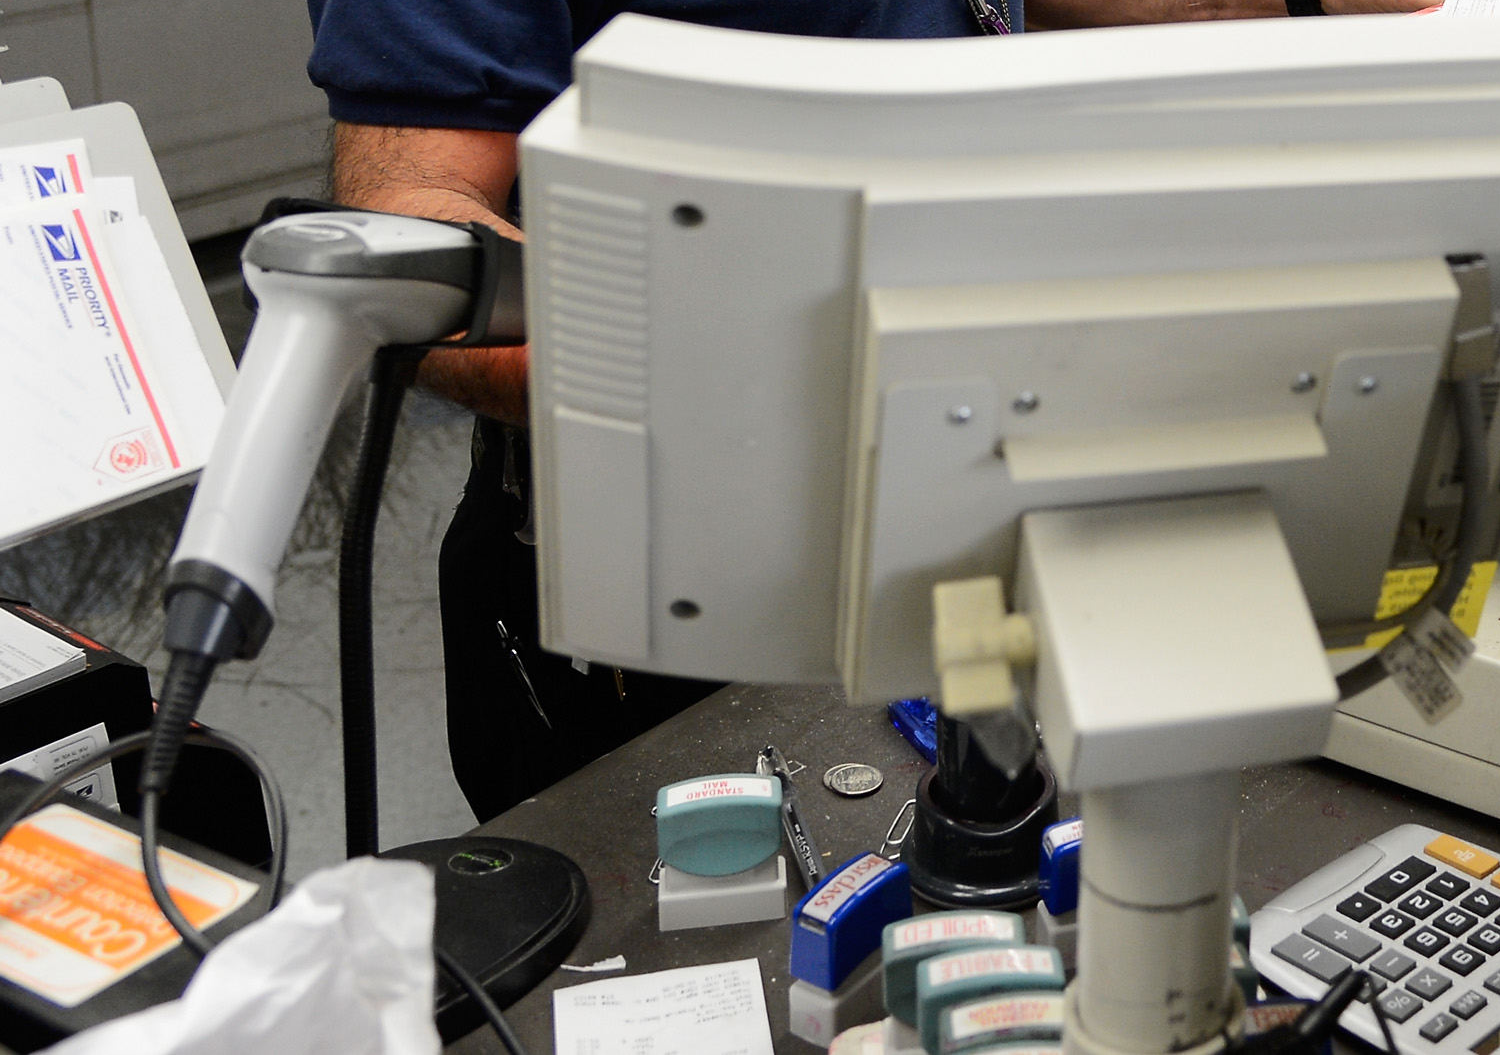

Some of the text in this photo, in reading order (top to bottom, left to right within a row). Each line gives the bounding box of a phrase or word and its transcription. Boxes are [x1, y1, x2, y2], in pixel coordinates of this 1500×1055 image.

[57, 268, 79, 304] MAIL
[75, 267, 110, 329] PRIORITY
[703, 781, 727, 789] MAIL
[686, 787, 744, 800] STANDARD
[795, 834, 811, 860] RSVP
[1389, 870, 1410, 884] 0
[1439, 879, 1455, 890] 1
[1408, 895, 1430, 910] 2
[1473, 894, 1490, 906] 4
[1381, 914, 1403, 929] 3
[1444, 912, 1466, 927] 5
[904, 917, 996, 944] SPOILED
[1479, 929, 1500, 944] 8
[1416, 932, 1438, 947] 6
[1451, 950, 1474, 965] 9
[1386, 995, 1410, 1010] %
[1458, 992, 1482, 1009] M+
